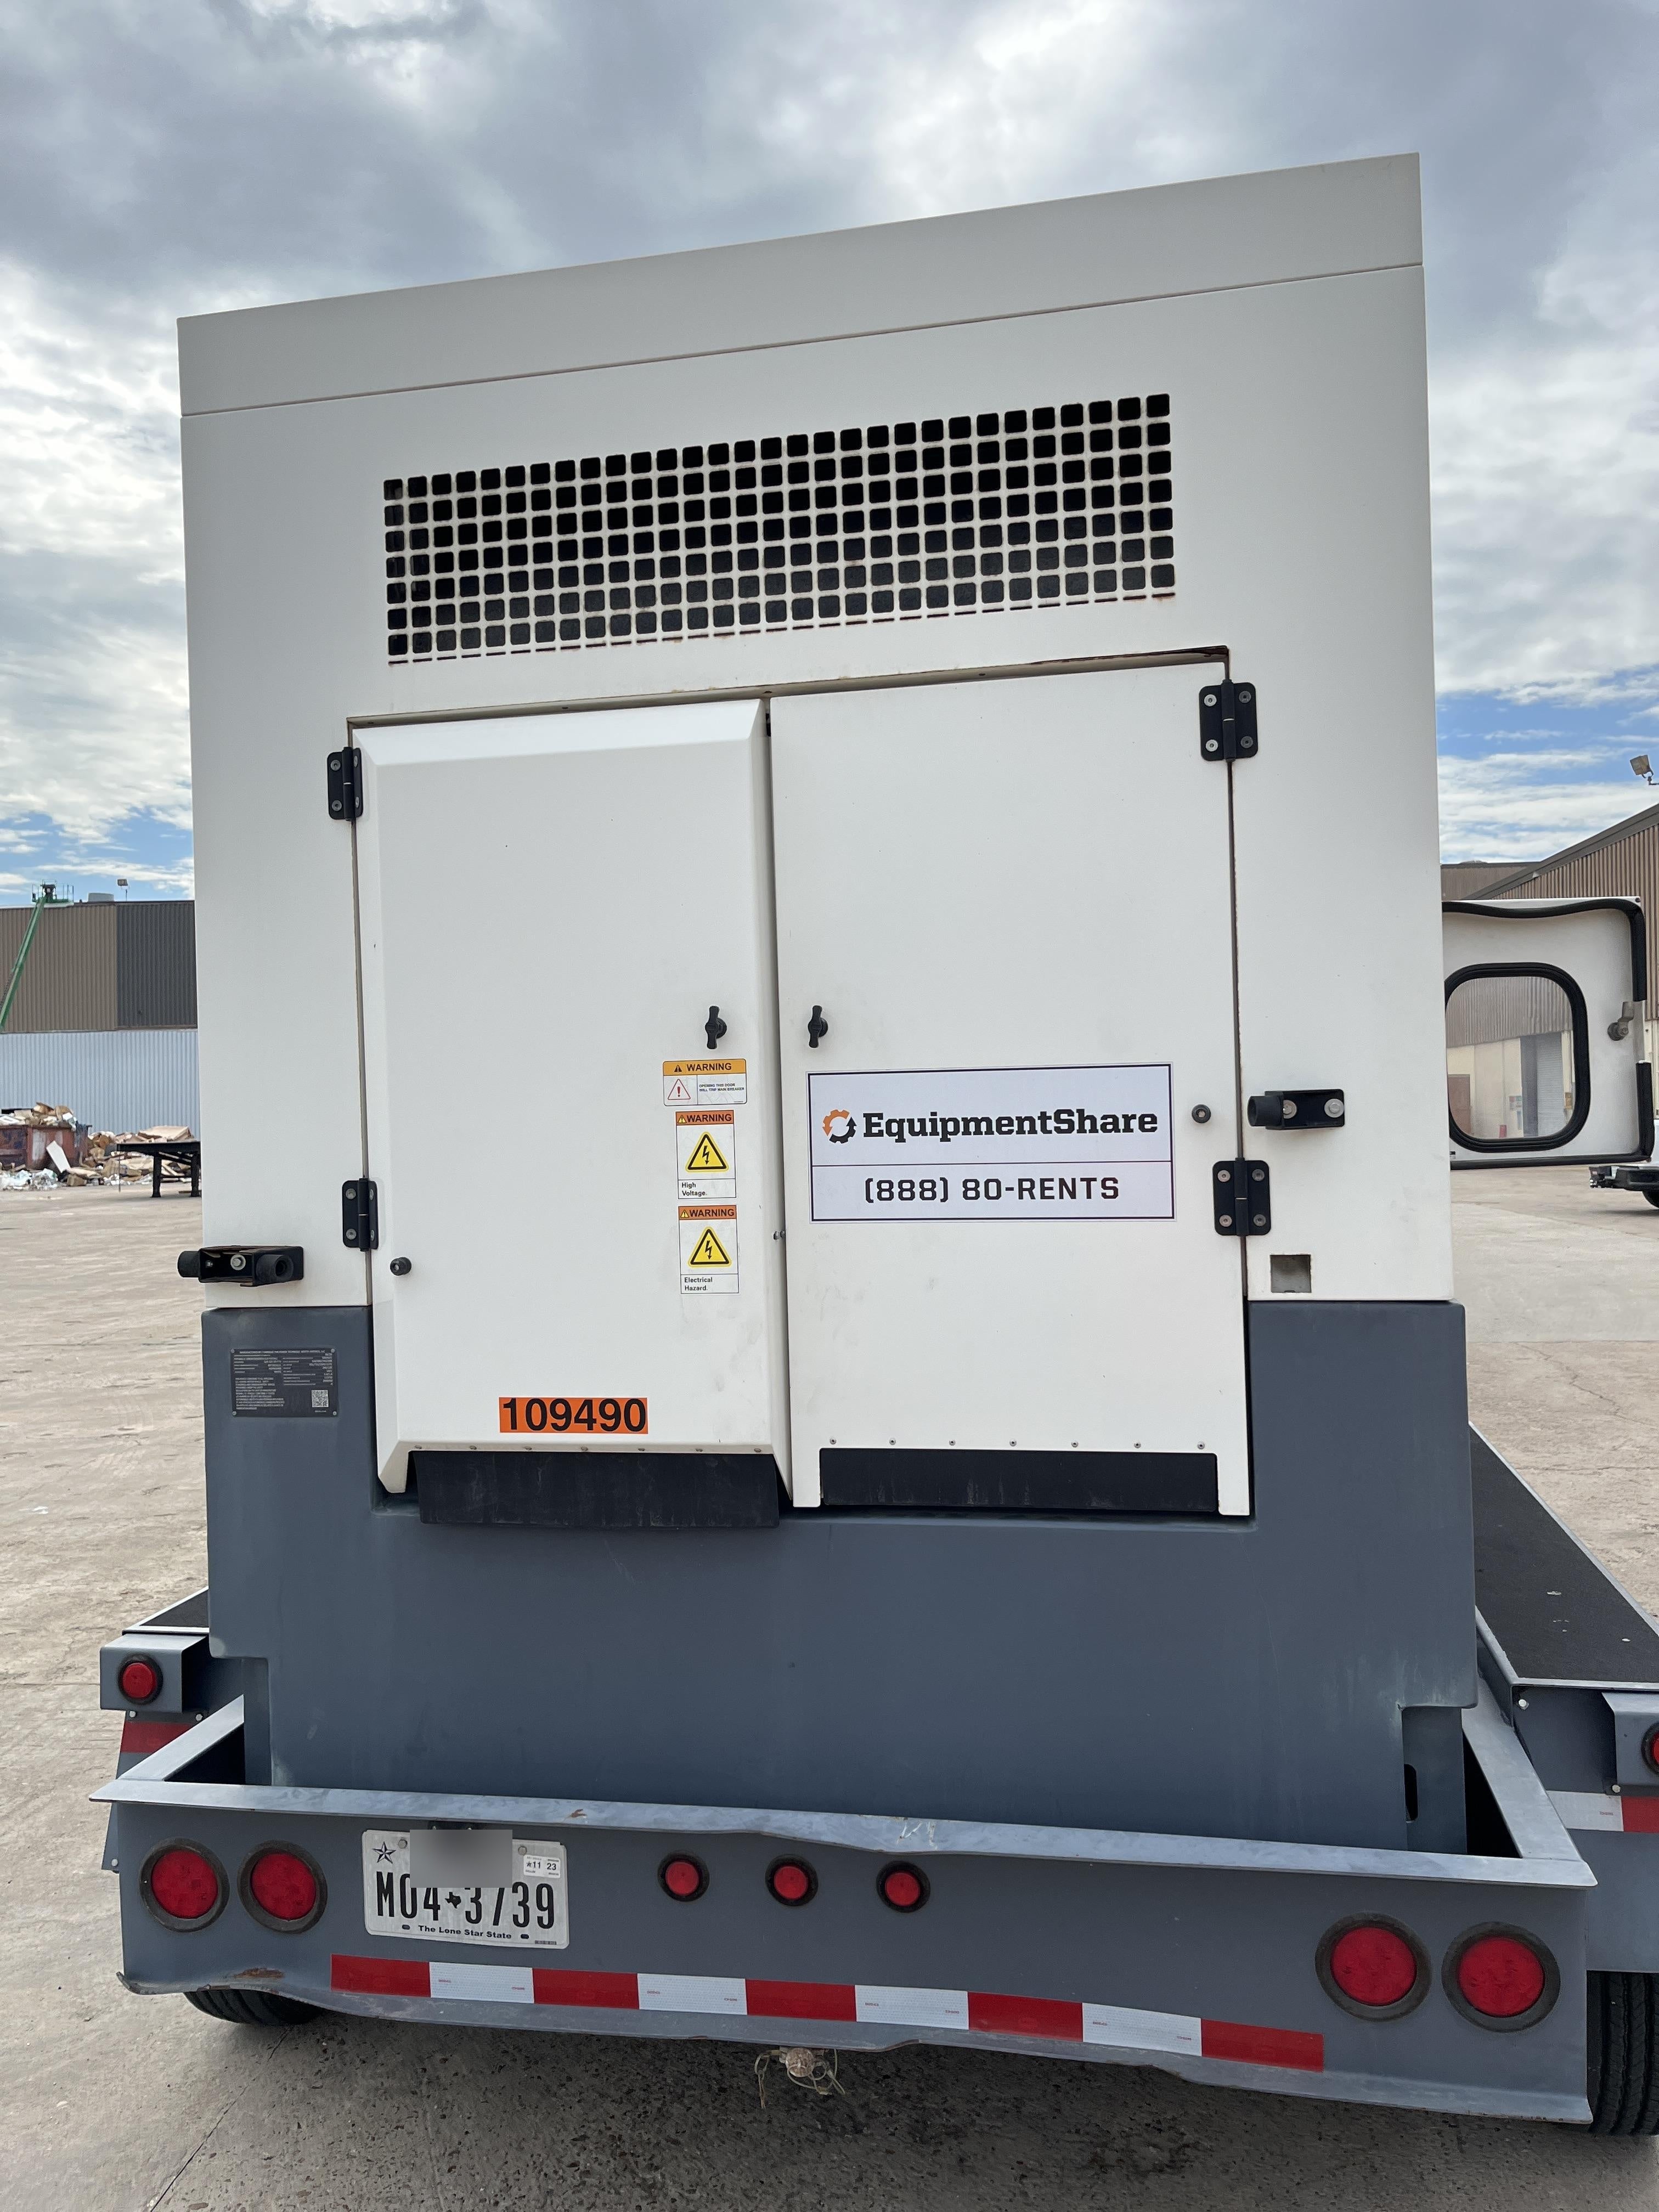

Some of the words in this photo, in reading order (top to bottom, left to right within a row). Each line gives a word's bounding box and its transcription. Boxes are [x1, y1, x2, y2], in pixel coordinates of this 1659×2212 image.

[687, 1063, 732, 1071] WARNING
[863, 1108, 1158, 1143] EquipmentShare
[865, 1177, 949, 1203] (888)
[962, 1177, 1119, 1200] 80-RENTS
[690, 1209, 735, 1217] WARNING
[503, 1398, 646, 1431] 109490
